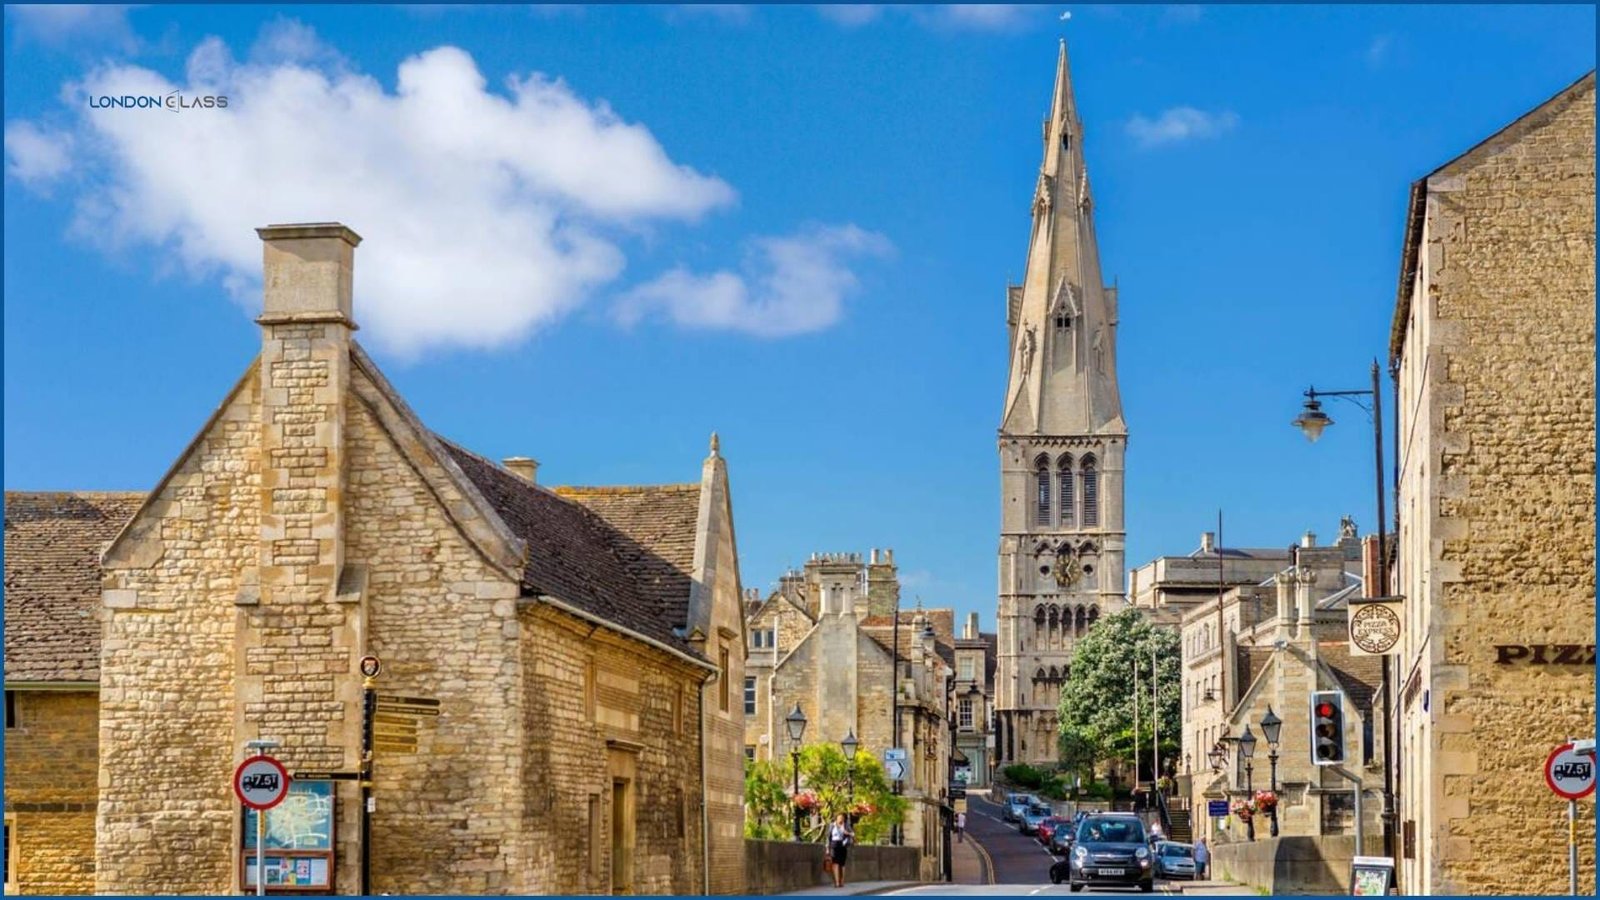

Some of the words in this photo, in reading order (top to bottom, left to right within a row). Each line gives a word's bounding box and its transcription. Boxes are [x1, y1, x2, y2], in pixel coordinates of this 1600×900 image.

[1363, 620, 1387, 628] PIZZA
[1357, 627, 1393, 635] EXPRESS
[1566, 763, 1589, 774] 7.5T
[254, 774, 276, 786] 7.5T
